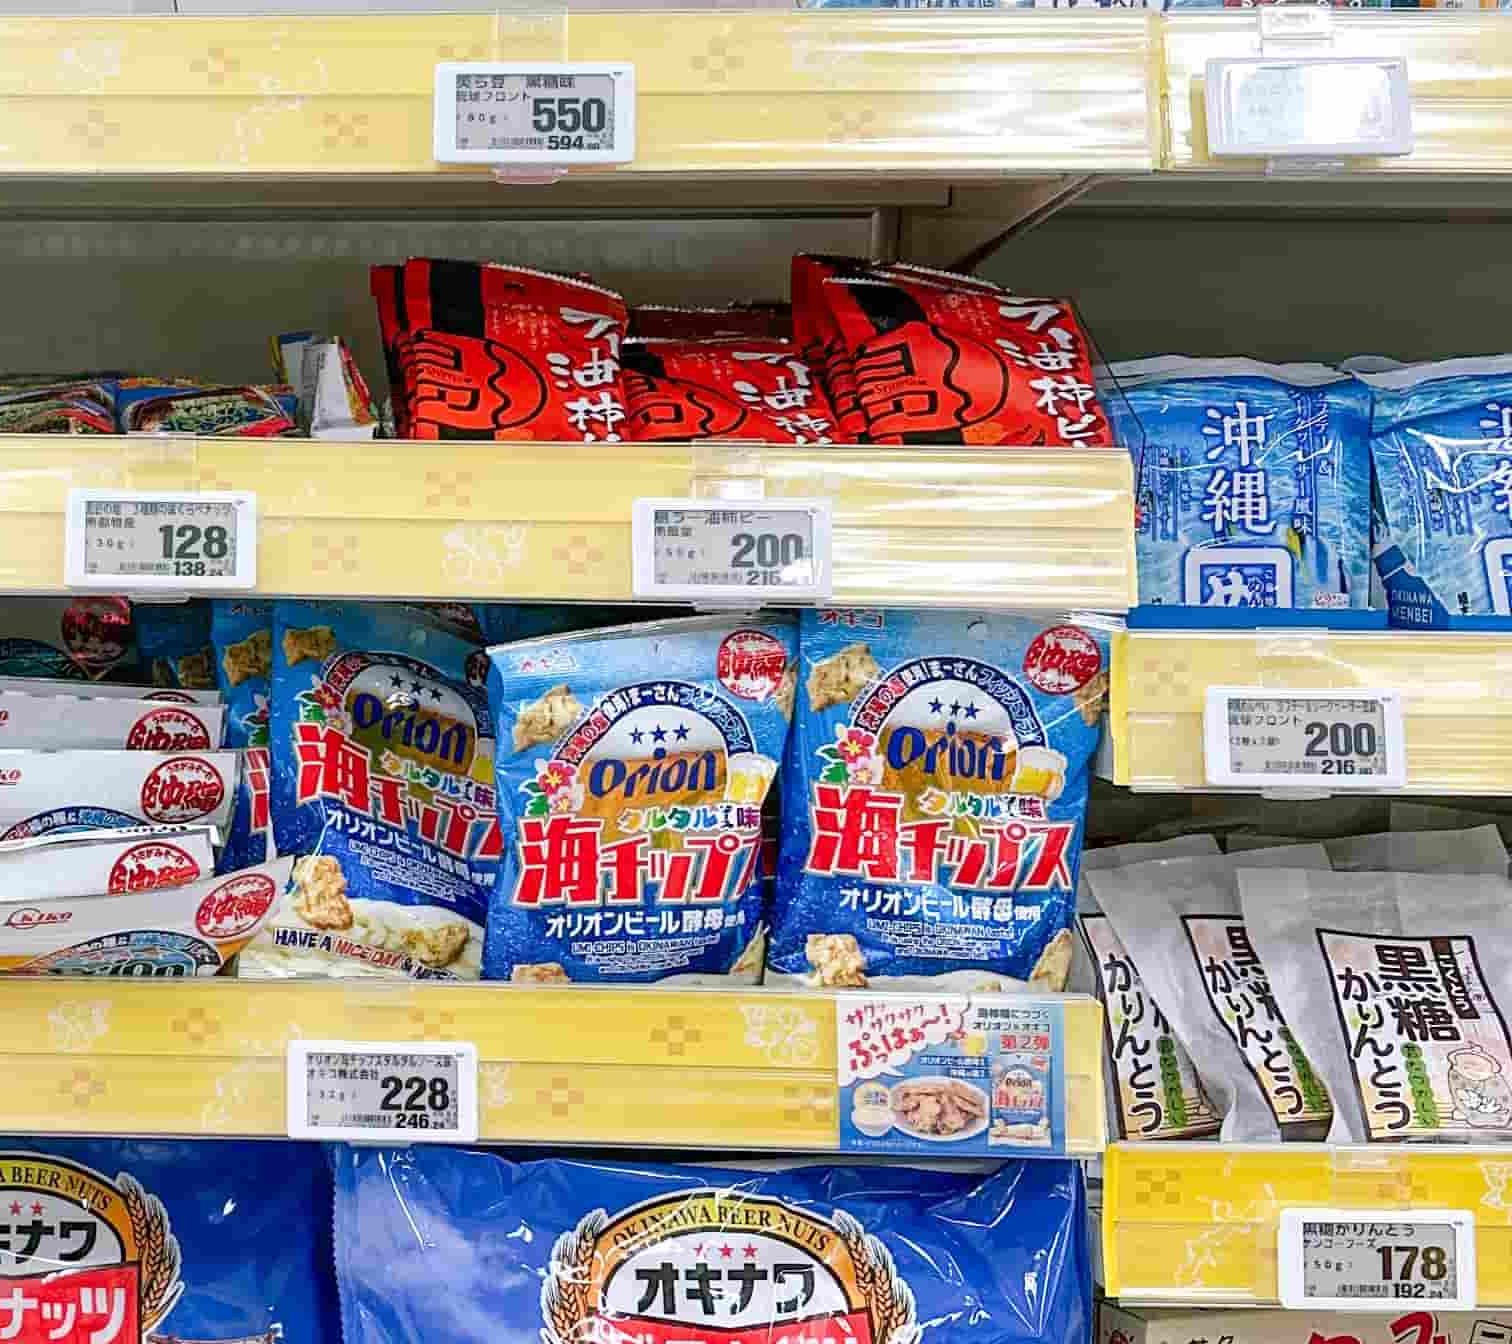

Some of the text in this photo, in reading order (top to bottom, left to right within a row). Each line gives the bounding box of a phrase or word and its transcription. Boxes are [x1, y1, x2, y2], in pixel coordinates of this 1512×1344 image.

[532, 97, 607, 133] 550
[1200, 400, 1277, 539] 沖縄
[158, 524, 228, 559] 128
[731, 533, 804, 569] 200
[351, 692, 467, 772] Orion
[886, 721, 1007, 782] Orion
[1304, 722, 1377, 758] 200
[588, 746, 718, 799] Orion
[805, 784, 1077, 891] 海チップス
[1374, 944, 1462, 1042] 黒糖
[1102, 953, 1165, 1136] かりんとう
[1204, 956, 1305, 1118] かりんとう
[1336, 966, 1411, 1131] かりんとう
[379, 1075, 450, 1112] 228
[8, 1164, 62, 1191] BEER
[776, 1210, 833, 1256] NUTS
[633, 1261, 814, 1315] オキナワ
[1376, 1245, 1447, 1282] 178
